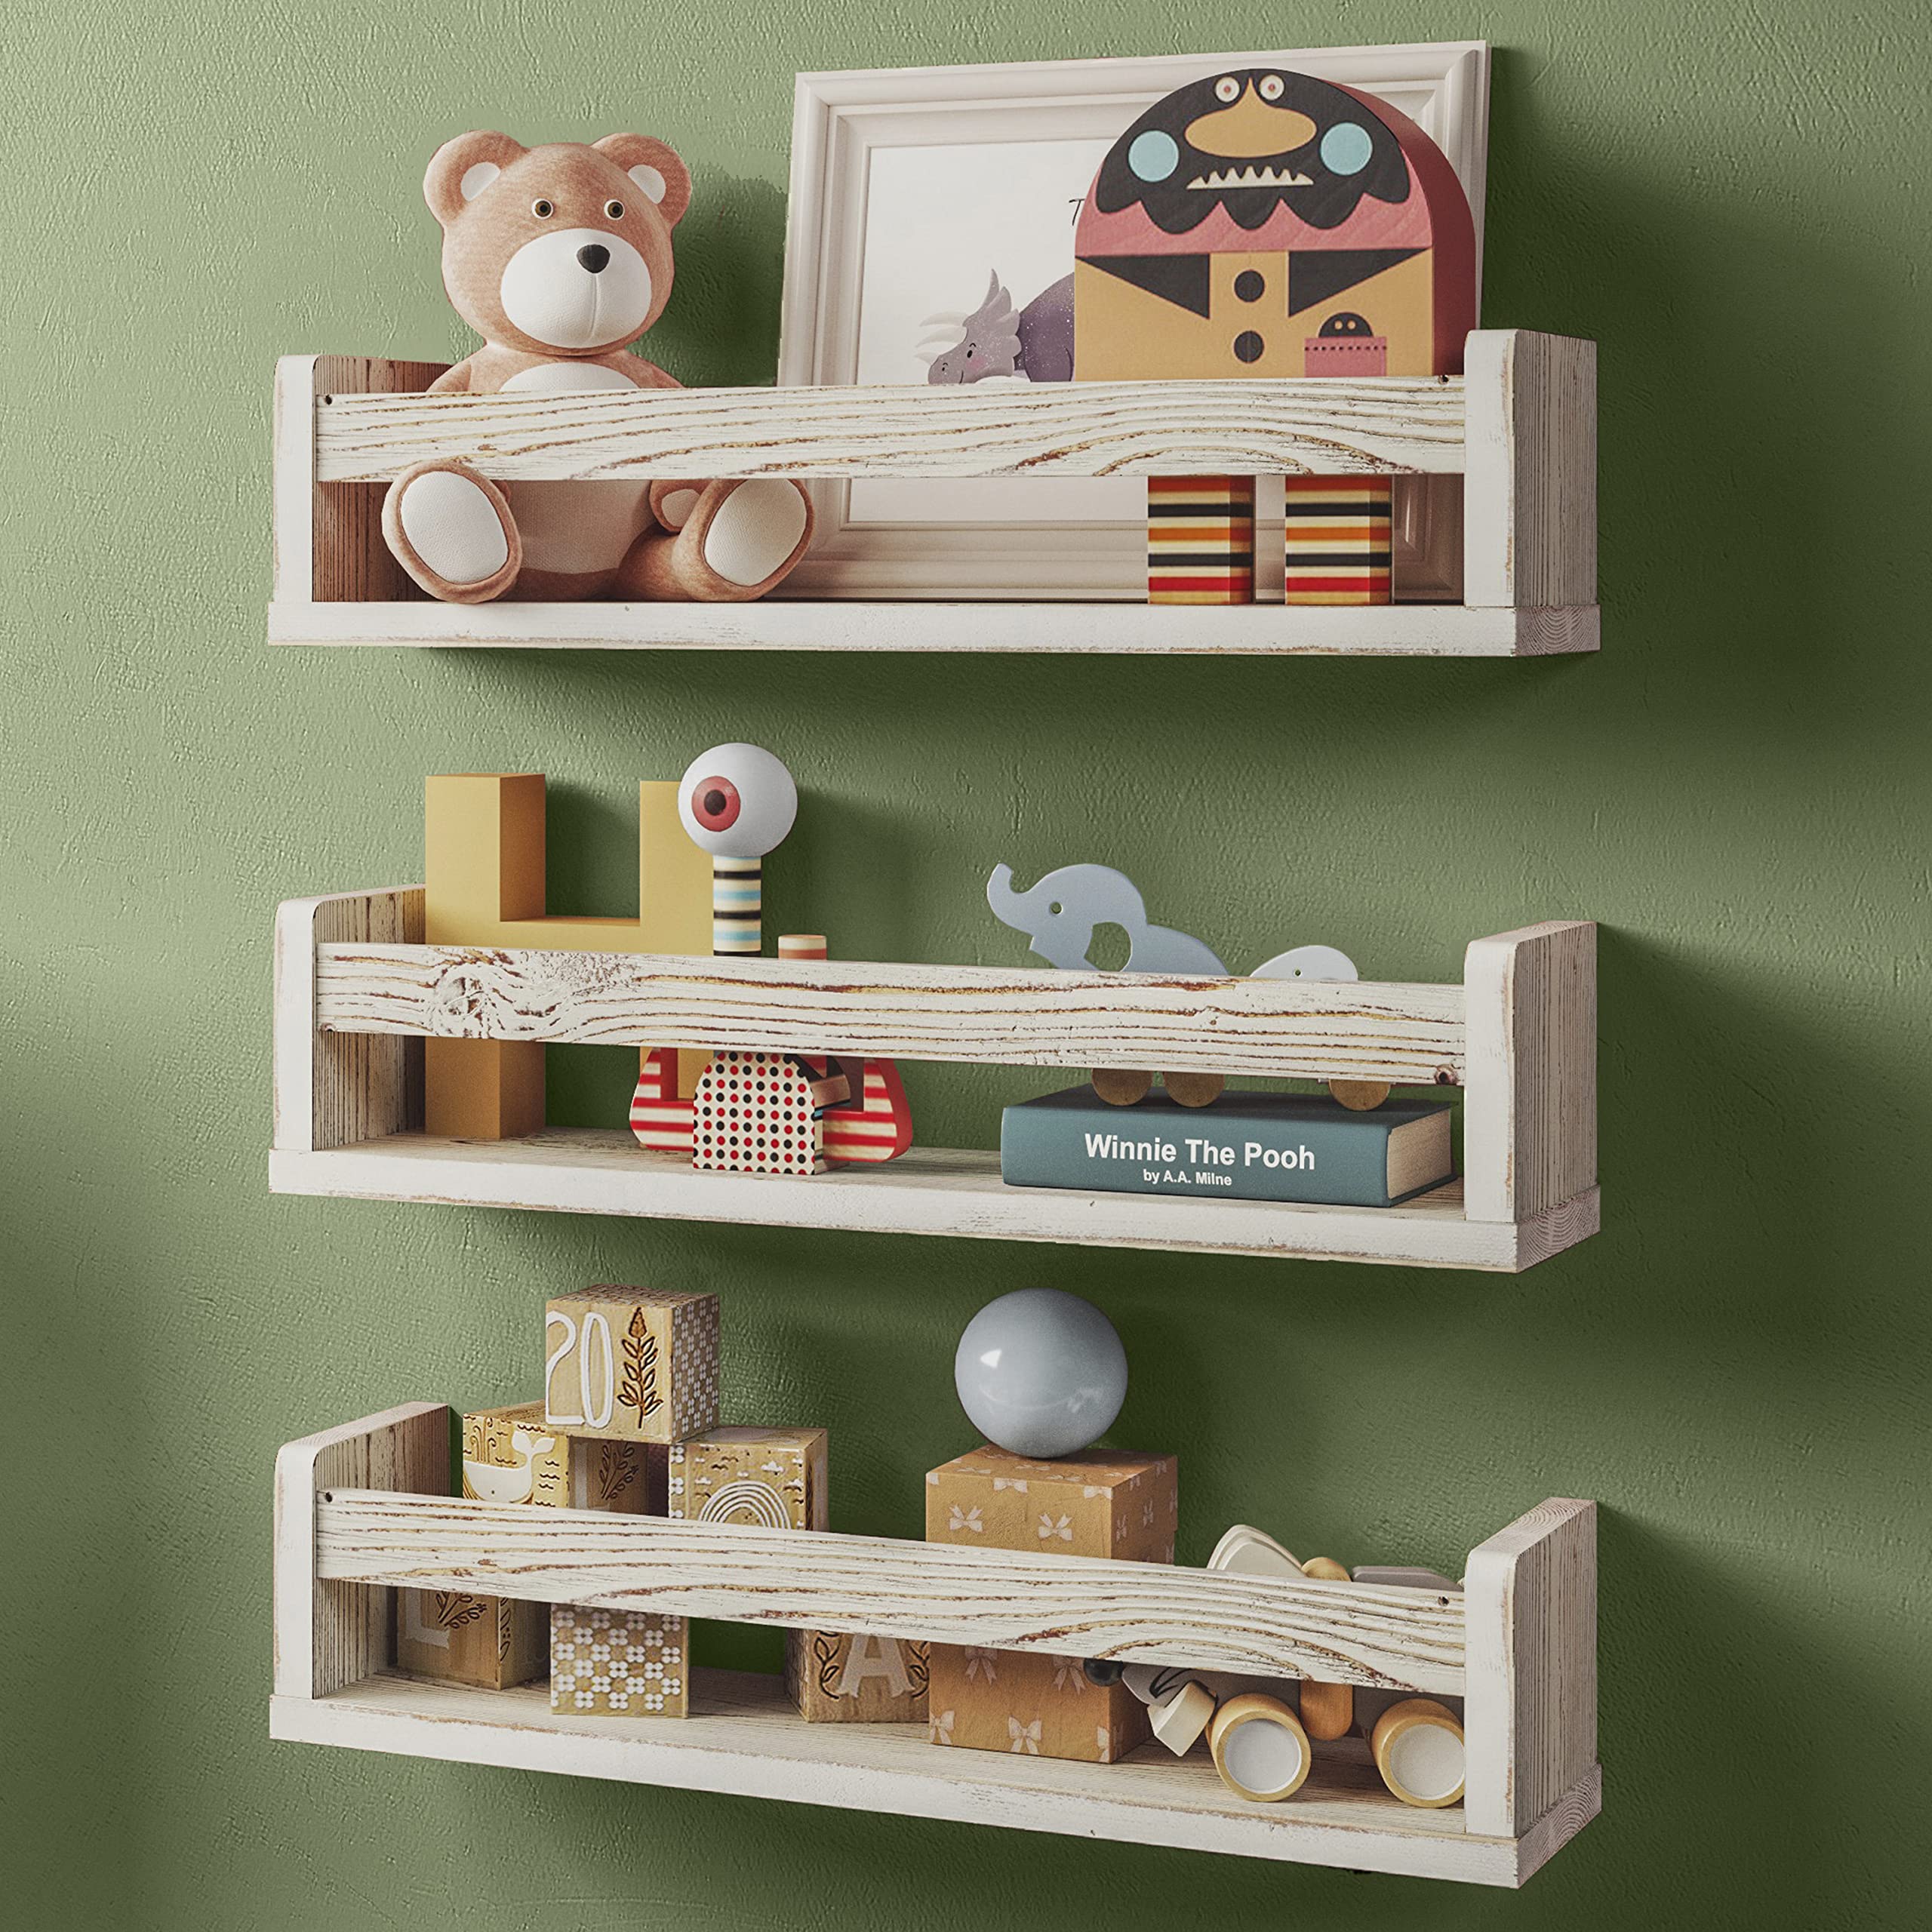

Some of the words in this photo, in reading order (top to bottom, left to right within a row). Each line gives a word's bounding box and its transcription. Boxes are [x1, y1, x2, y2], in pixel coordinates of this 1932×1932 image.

[1084, 1133, 1177, 1162] Winnie
[1185, 1138, 1235, 1166] The
[1244, 1142, 1315, 1171] Pooh
[1143, 1168, 1160, 1185] by
[1163, 1170, 1192, 1184] A.A.
[1195, 1172, 1232, 1186] Milne
[546, 1310, 614, 1429] 20
[835, 1633, 916, 1699] A
